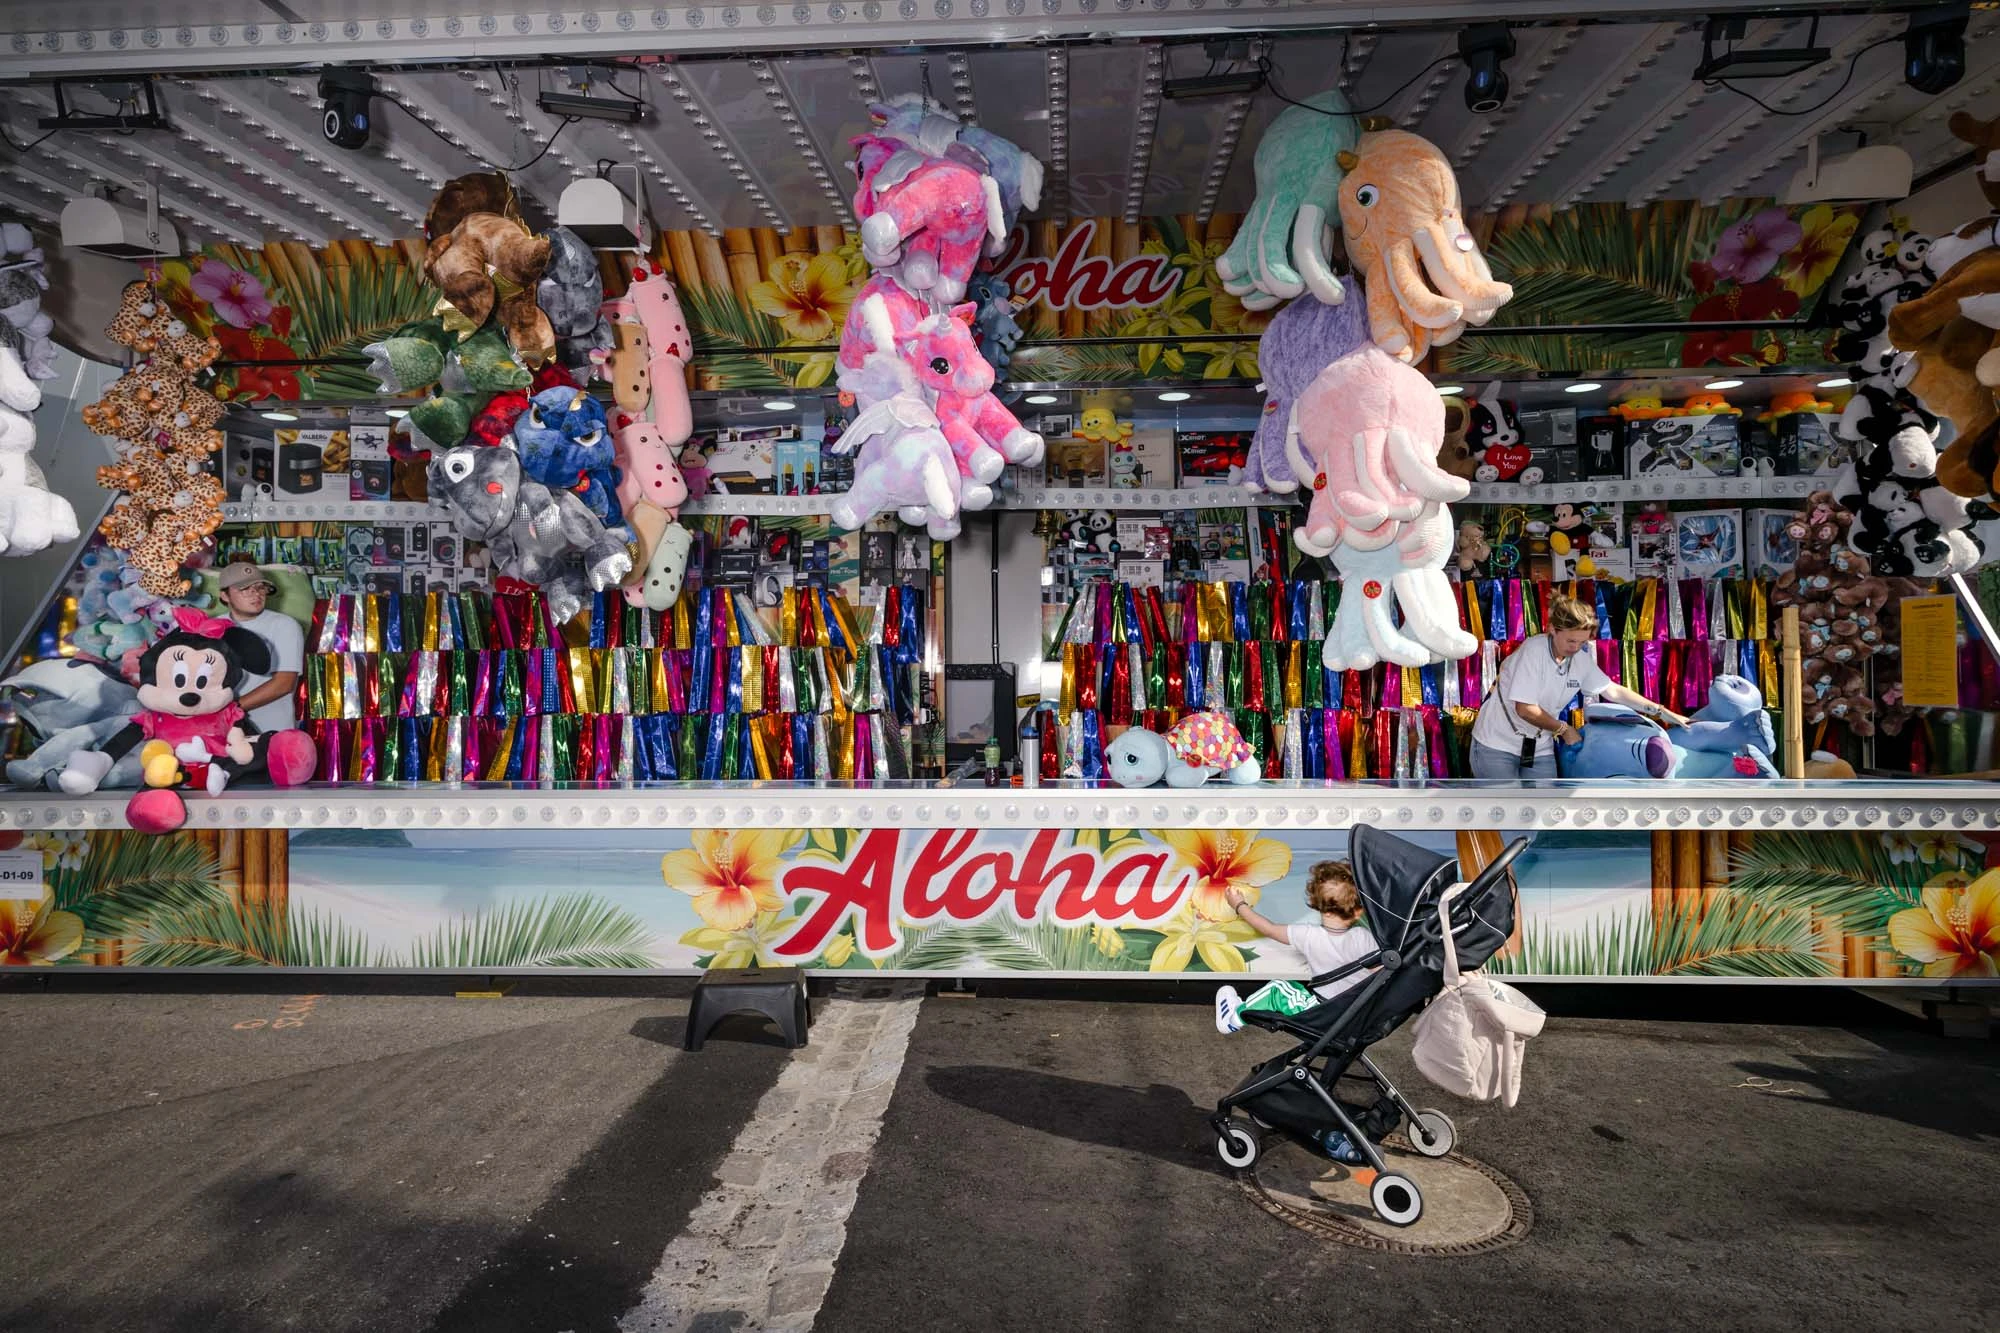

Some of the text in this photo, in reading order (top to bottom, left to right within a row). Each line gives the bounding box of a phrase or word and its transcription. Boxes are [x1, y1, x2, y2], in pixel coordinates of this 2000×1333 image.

[991, 222, 1180, 308] oha
[1502, 461, 1517, 470] You
[773, 828, 1189, 956] Aloha
